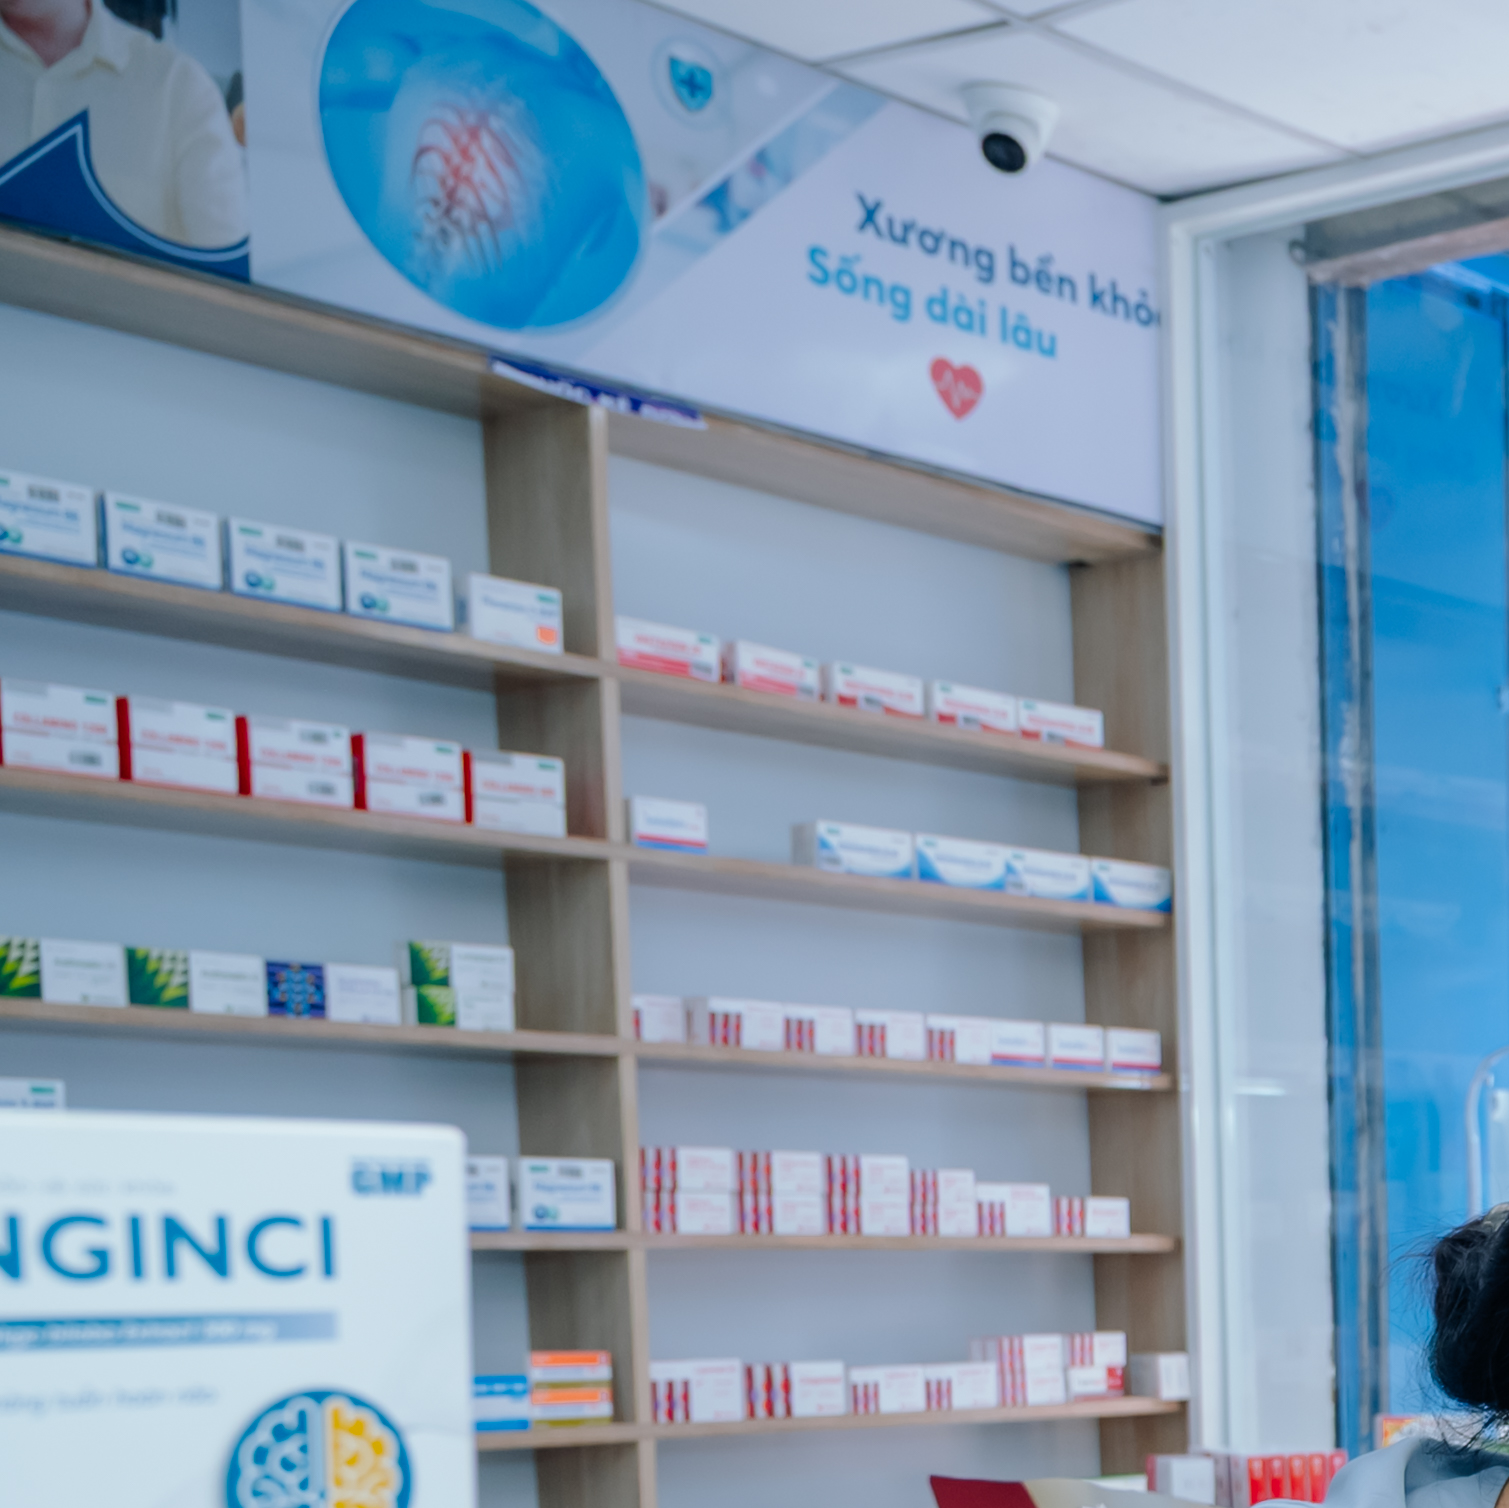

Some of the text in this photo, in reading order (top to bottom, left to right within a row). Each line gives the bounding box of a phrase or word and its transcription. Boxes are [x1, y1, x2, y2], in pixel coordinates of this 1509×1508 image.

[857, 194, 997, 284] Xương
[806, 246, 1058, 360] Sống dài lâu
